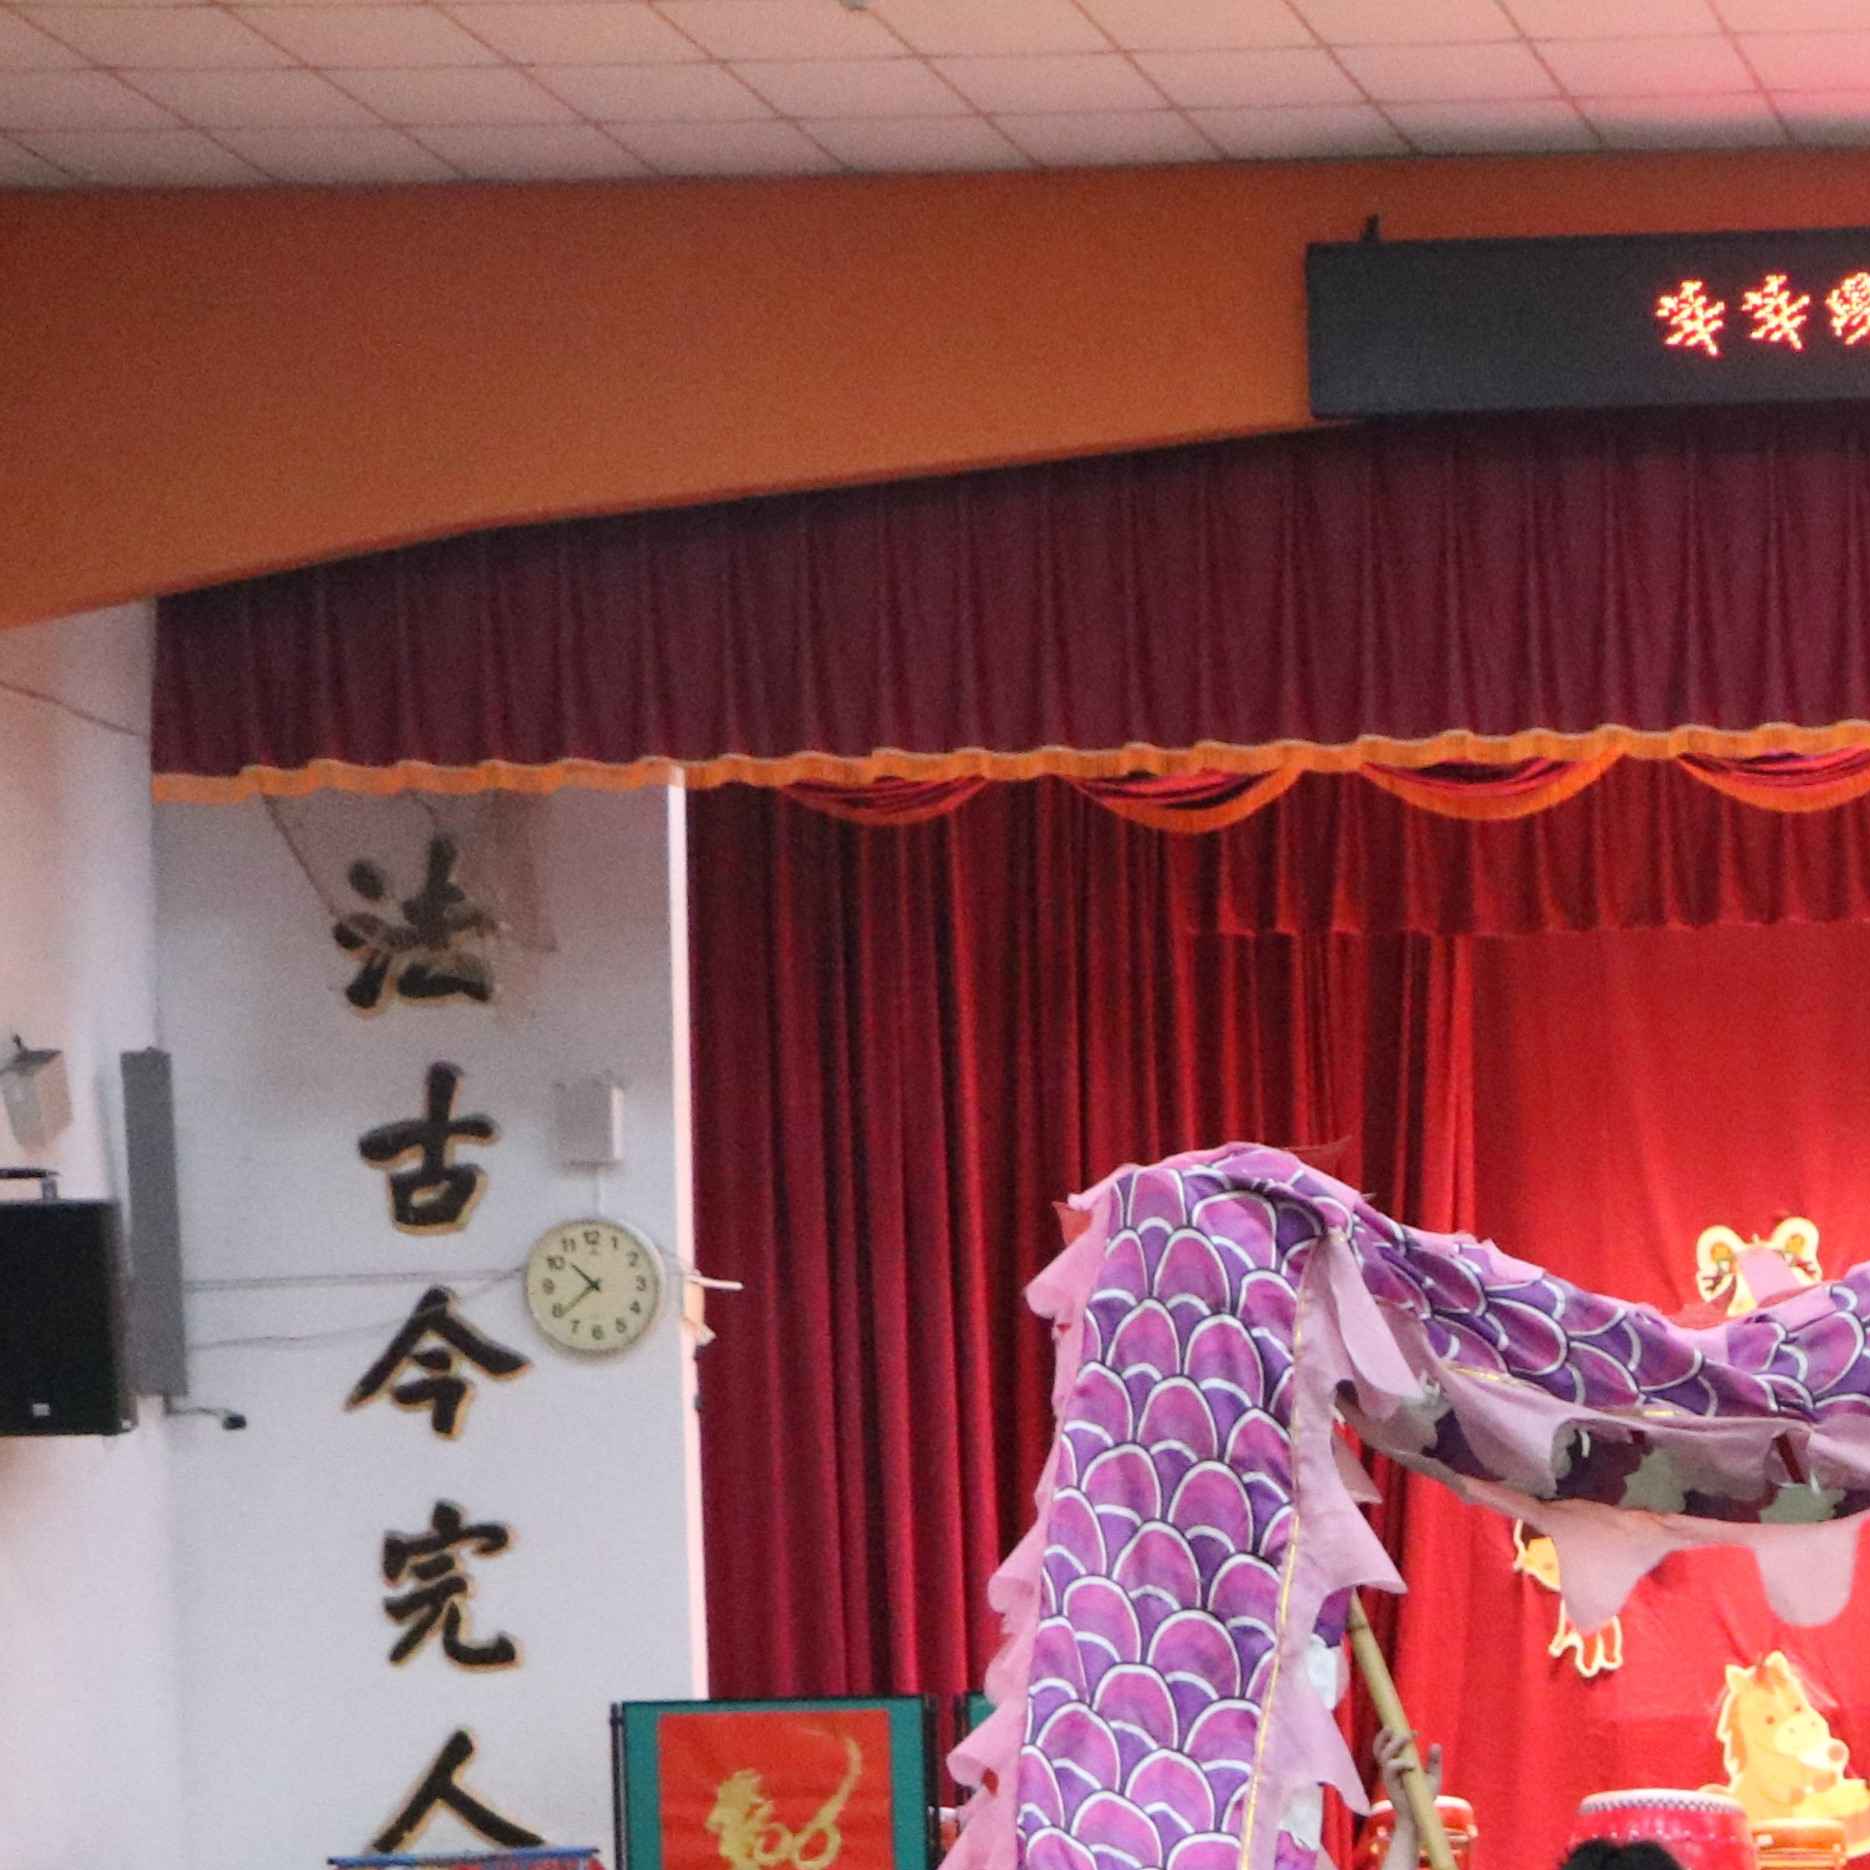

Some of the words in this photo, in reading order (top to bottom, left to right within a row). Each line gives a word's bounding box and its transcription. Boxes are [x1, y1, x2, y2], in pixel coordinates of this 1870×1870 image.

[334, 834, 545, 1851] 法古今完人
